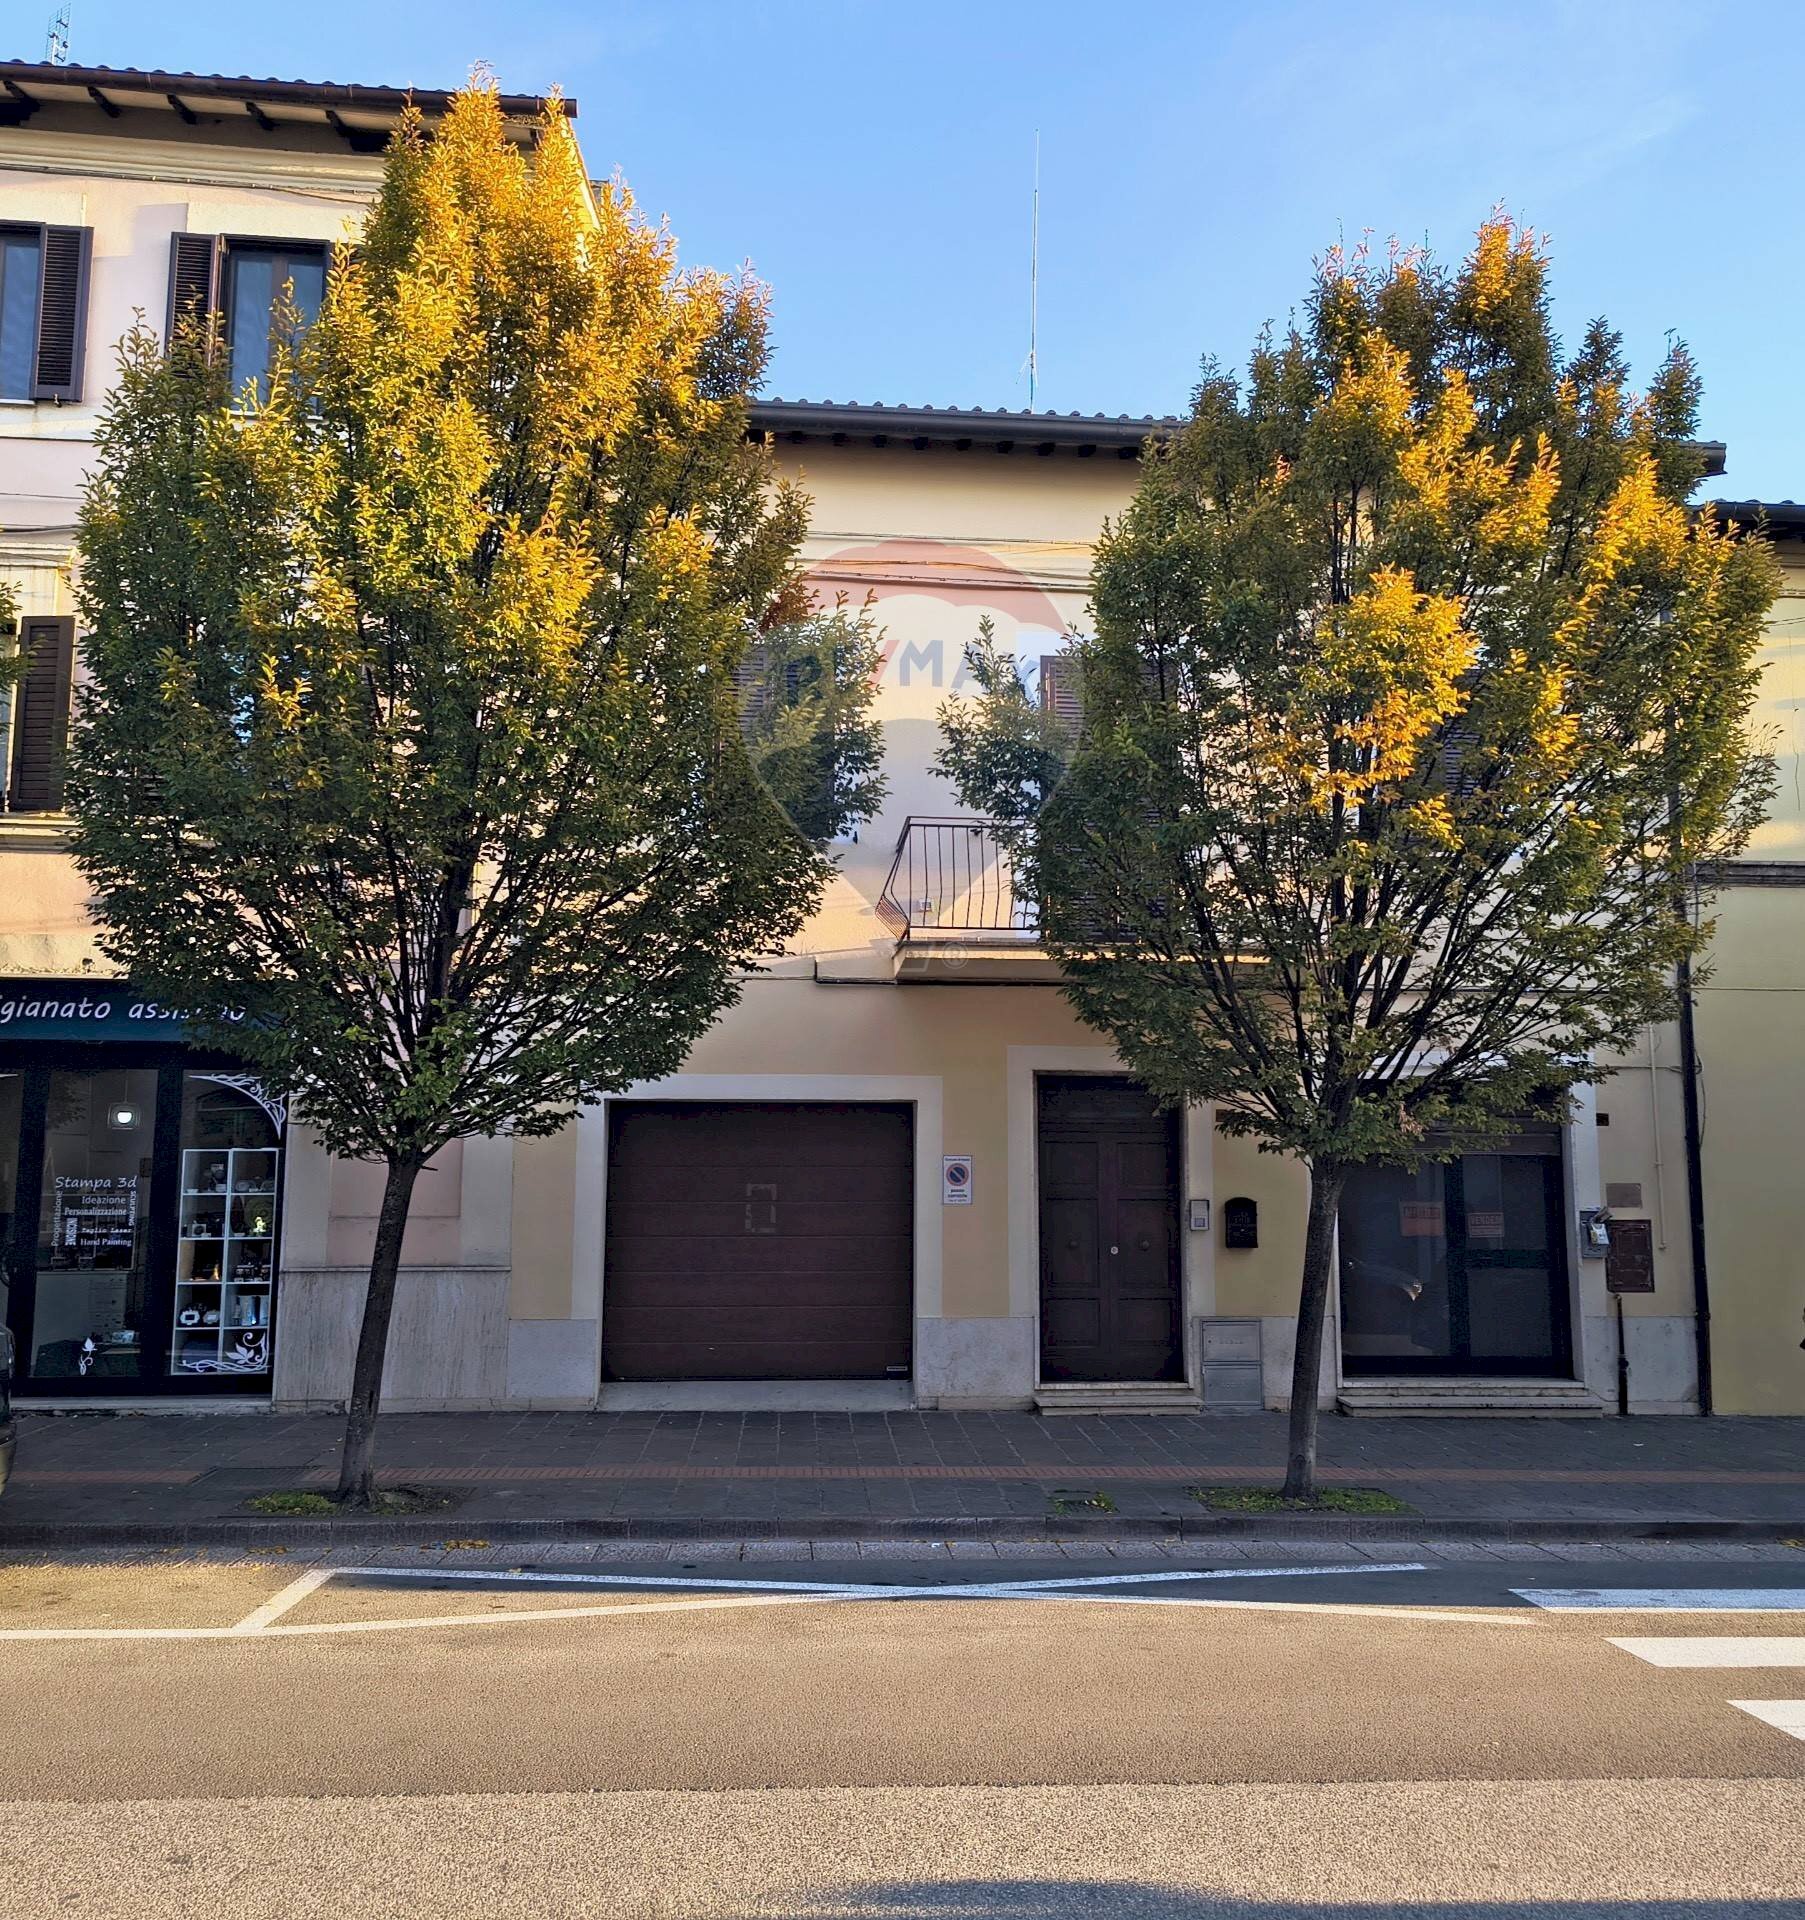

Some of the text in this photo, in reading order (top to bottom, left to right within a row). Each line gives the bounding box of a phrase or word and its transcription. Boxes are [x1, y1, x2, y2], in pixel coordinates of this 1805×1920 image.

[0, 995, 111, 1023] gianato
[55, 1175, 137, 1191] Stampa 3d
[81, 1196, 126, 1204] Ideazione
[128, 1190, 137, 1226] SCULPTING
[51, 1191, 63, 1247] Progettazione
[64, 1207, 127, 1215] Personalizzazione
[80, 1238, 132, 1247] Hand Painting
